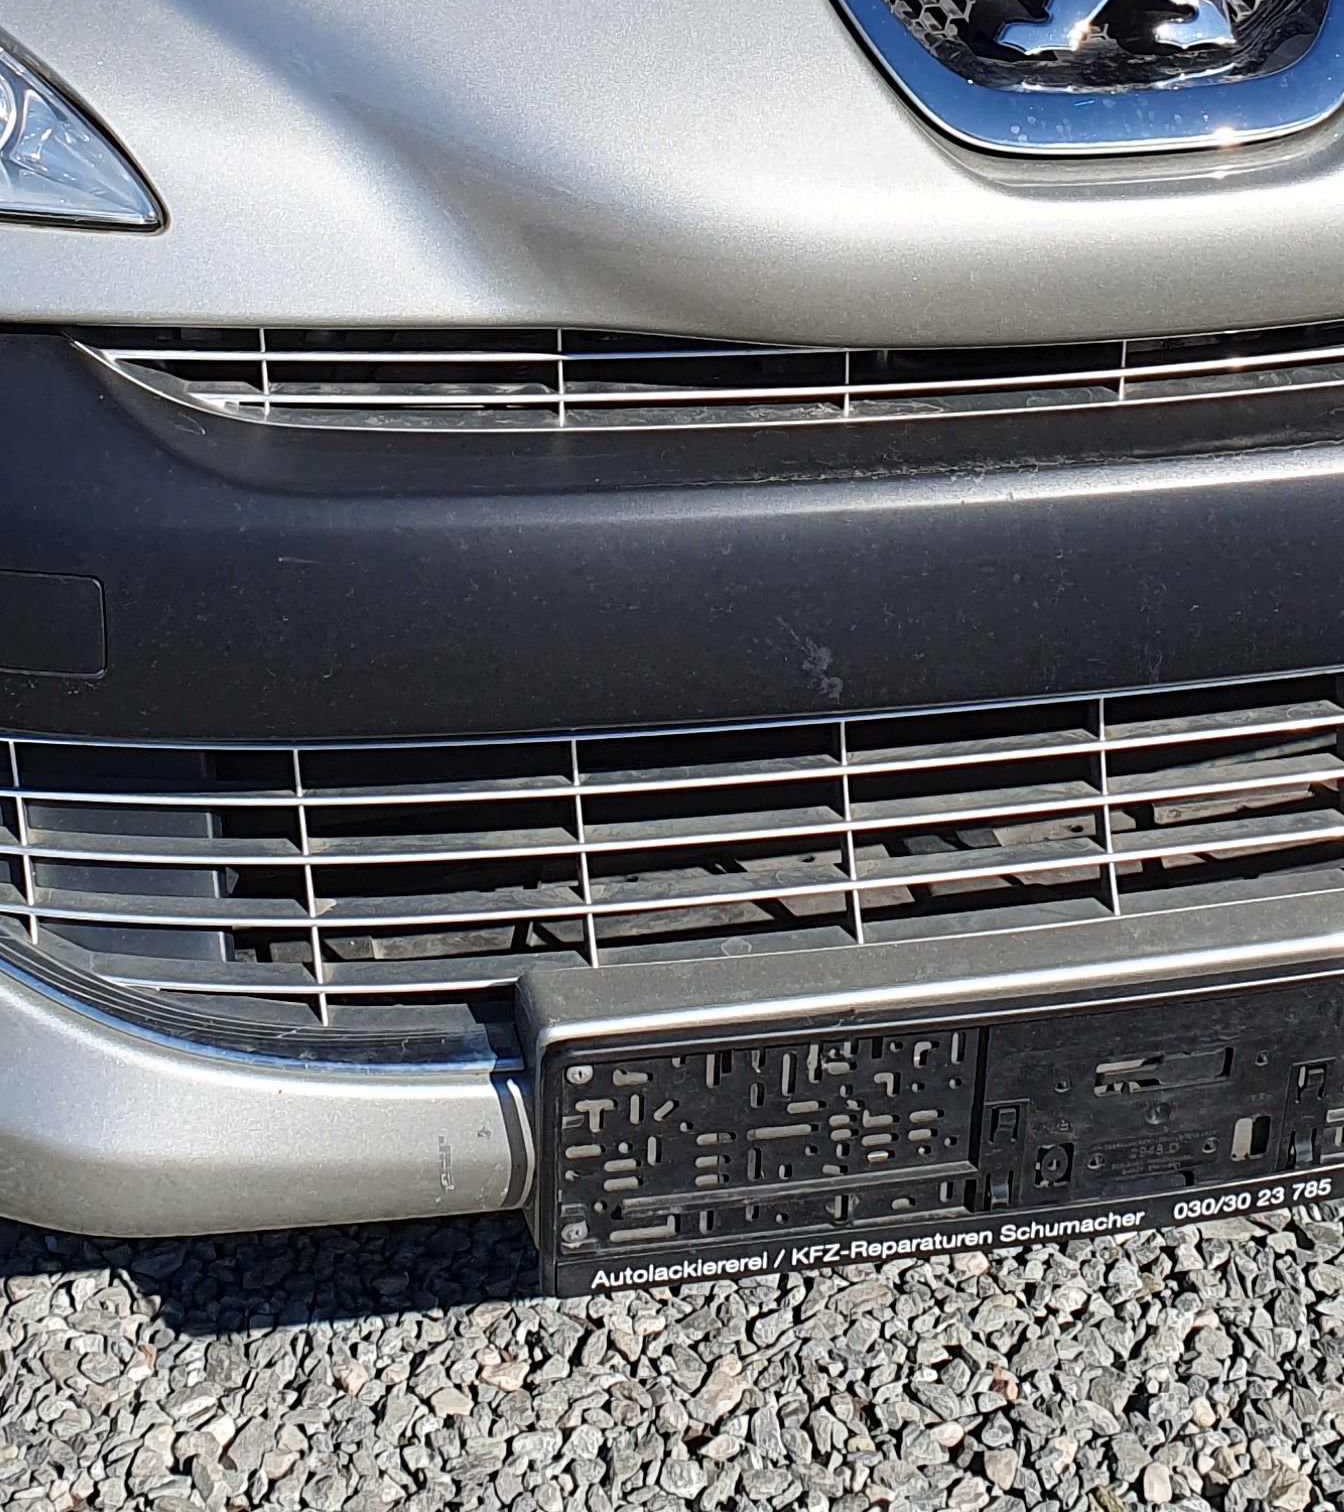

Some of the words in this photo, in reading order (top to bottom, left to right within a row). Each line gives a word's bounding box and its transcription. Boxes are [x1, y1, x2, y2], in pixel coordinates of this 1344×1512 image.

[591, 1252, 768, 1289] Autolackiererei
[791, 1228, 994, 1268] KFZ-Reparaturen
[999, 1209, 1146, 1241] Schumacher
[1173, 1191, 1251, 1220] 030/30
[1257, 1186, 1286, 1208] 23
[1292, 1178, 1332, 1202] 785
